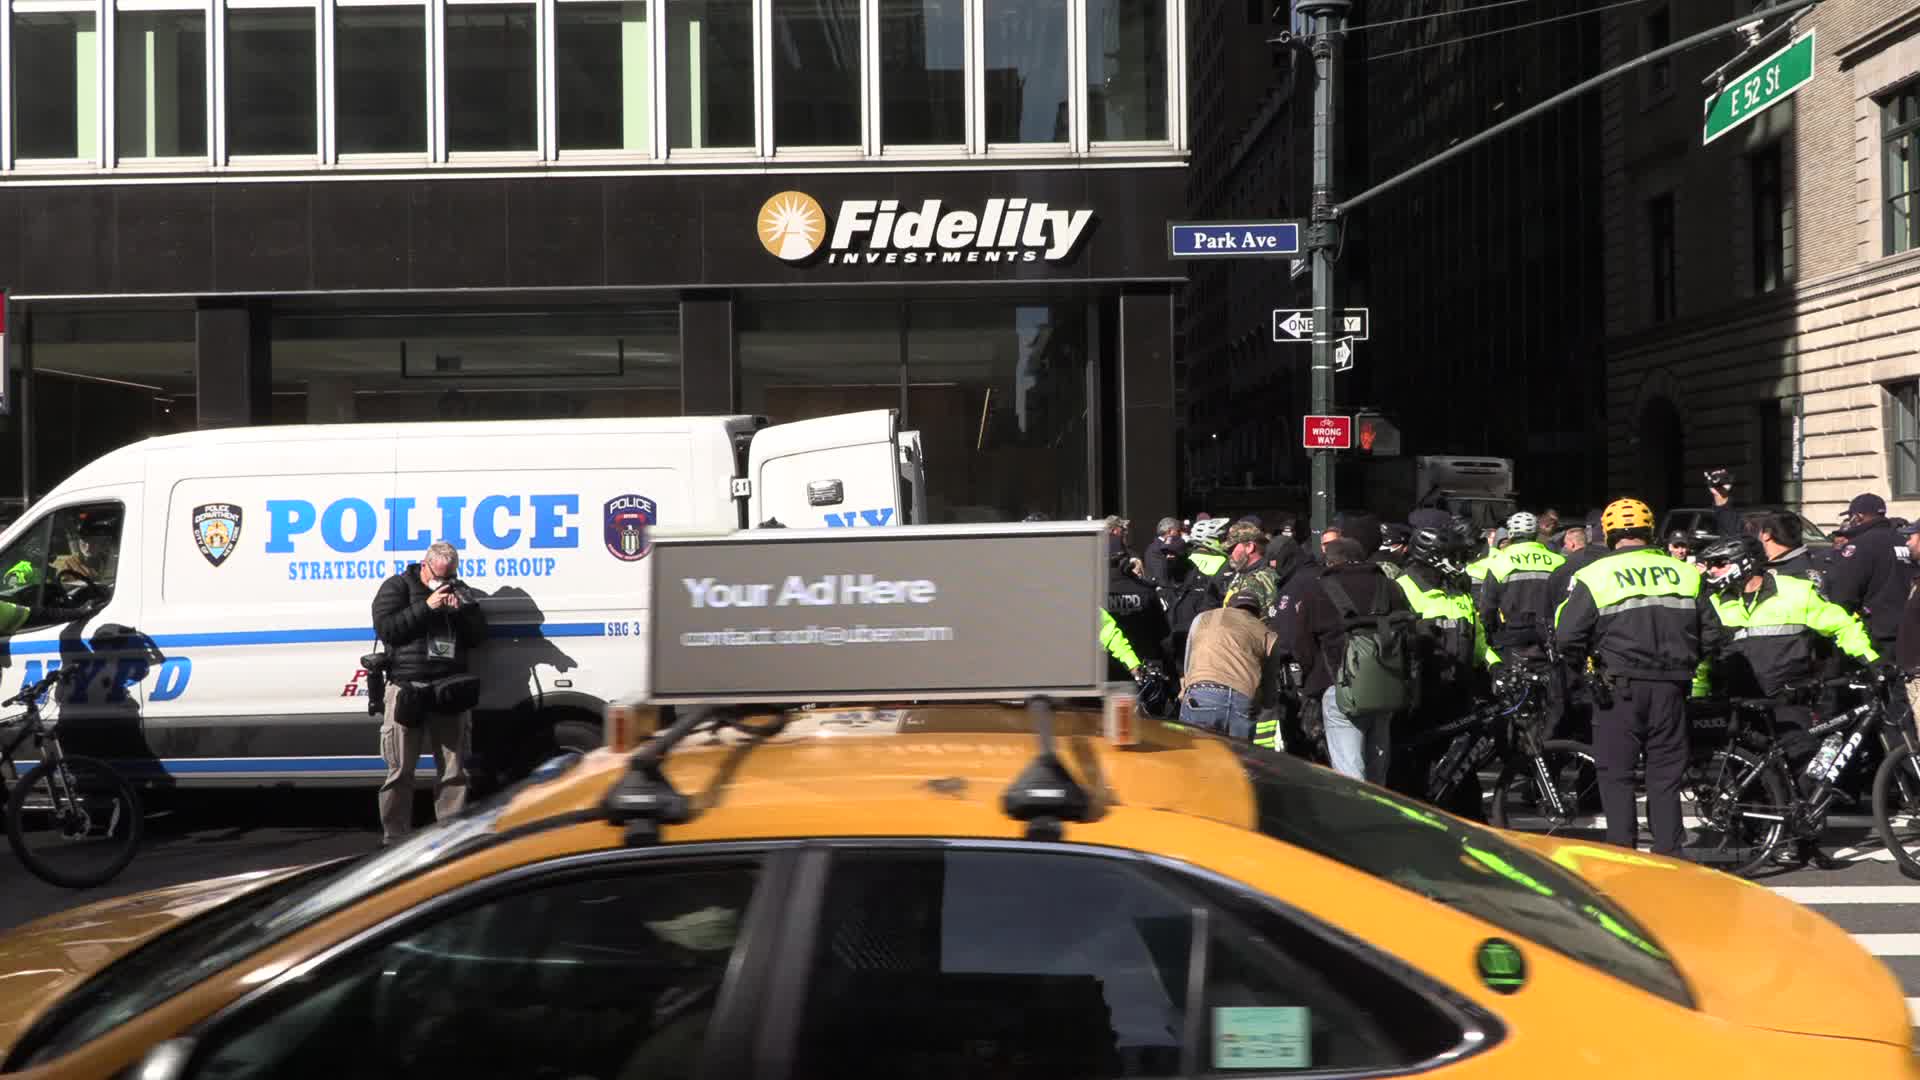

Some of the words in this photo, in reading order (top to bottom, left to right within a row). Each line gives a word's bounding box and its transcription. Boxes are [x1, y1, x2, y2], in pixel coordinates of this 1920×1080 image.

[1731, 89, 1740, 117] E
[1744, 76, 1761, 109] 52
[1765, 64, 1780, 95] St
[830, 198, 1093, 260] Fidelity
[1193, 232, 1237, 249] Park
[1241, 232, 1278, 248] Ave
[828, 250, 1037, 264] INVESTMENTS
[1288, 319, 1313, 331] ONE
[1312, 427, 1342, 437] WRONG
[1317, 436, 1336, 445] WAY
[609, 496, 652, 514] POLICE
[265, 494, 579, 553] POLICE
[1510, 553, 1553, 566] NYPD
[288, 560, 386, 580] STRATEGIC
[394, 558, 486, 578] RNSE
[495, 557, 555, 577] GROUP
[1614, 566, 1681, 588] NYPD
[682, 576, 774, 608] Your
[775, 574, 836, 606] Ad
[838, 574, 937, 605] Here
[1106, 594, 1141, 608] NYPD
[607, 621, 629, 637] SRG
[633, 621, 641, 637] 3
[1826, 732, 1863, 783] NYPD
